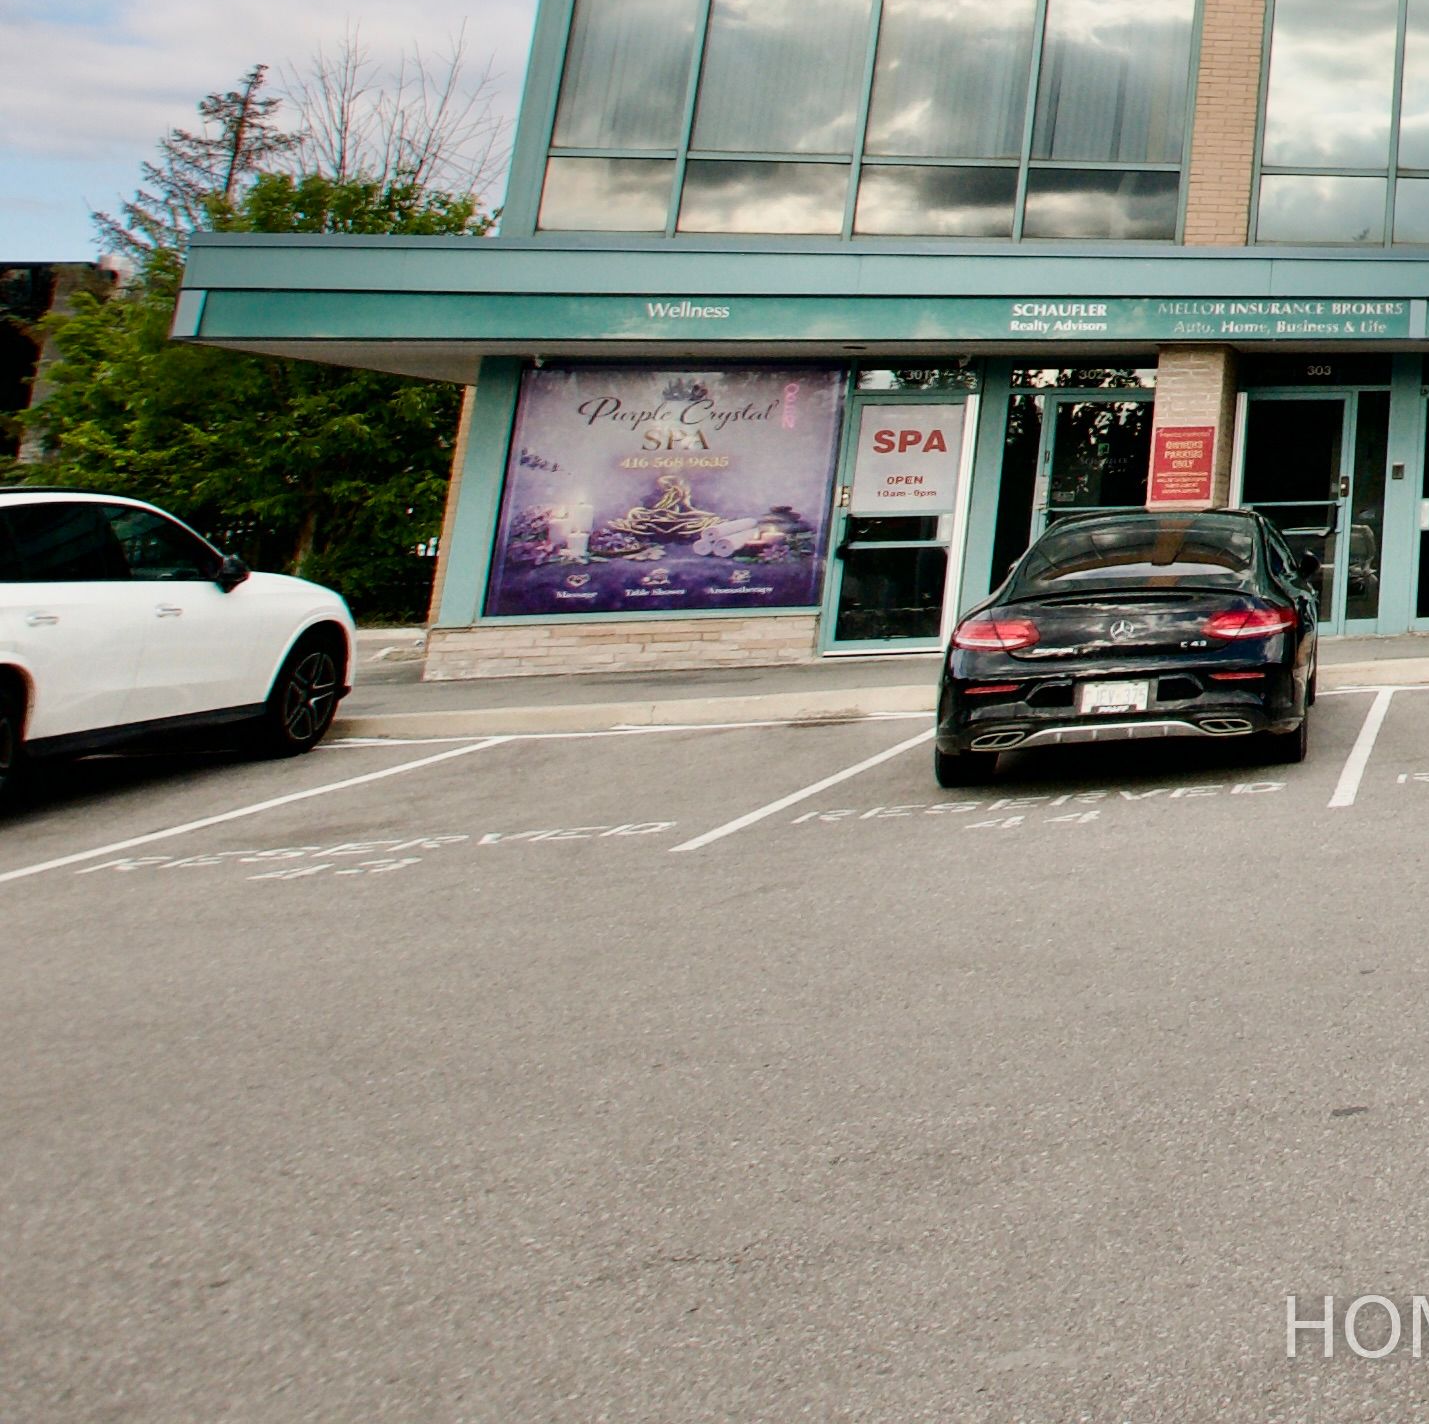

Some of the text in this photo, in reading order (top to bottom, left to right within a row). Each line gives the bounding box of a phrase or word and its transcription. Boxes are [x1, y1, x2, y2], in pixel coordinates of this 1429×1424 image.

[646, 301, 730, 318] Wellness
[1012, 304, 1107, 317] SCHAUFLER
[1158, 302, 1403, 315] MELLOR INSURANCE BROKERS
[1010, 320, 1107, 334] Realty Advisors
[1276, 320, 1339, 333] Business
[1344, 322, 1354, 332] &
[1360, 320, 1387, 333] Life
[1307, 365, 1332, 376] 303
[578, 396, 779, 431] Purple Crystal
[641, 429, 711, 451] SPA
[873, 429, 947, 453] SPA
[620, 457, 649, 469] 416
[688, 456, 729, 468] 9635
[886, 475, 923, 485] OPEN
[877, 489, 906, 497] 10am
[790, 781, 1287, 824] RESERVED
[965, 810, 1101, 829] 44
[75, 822, 677, 874] RESERVED
[247, 858, 422, 880] 43
